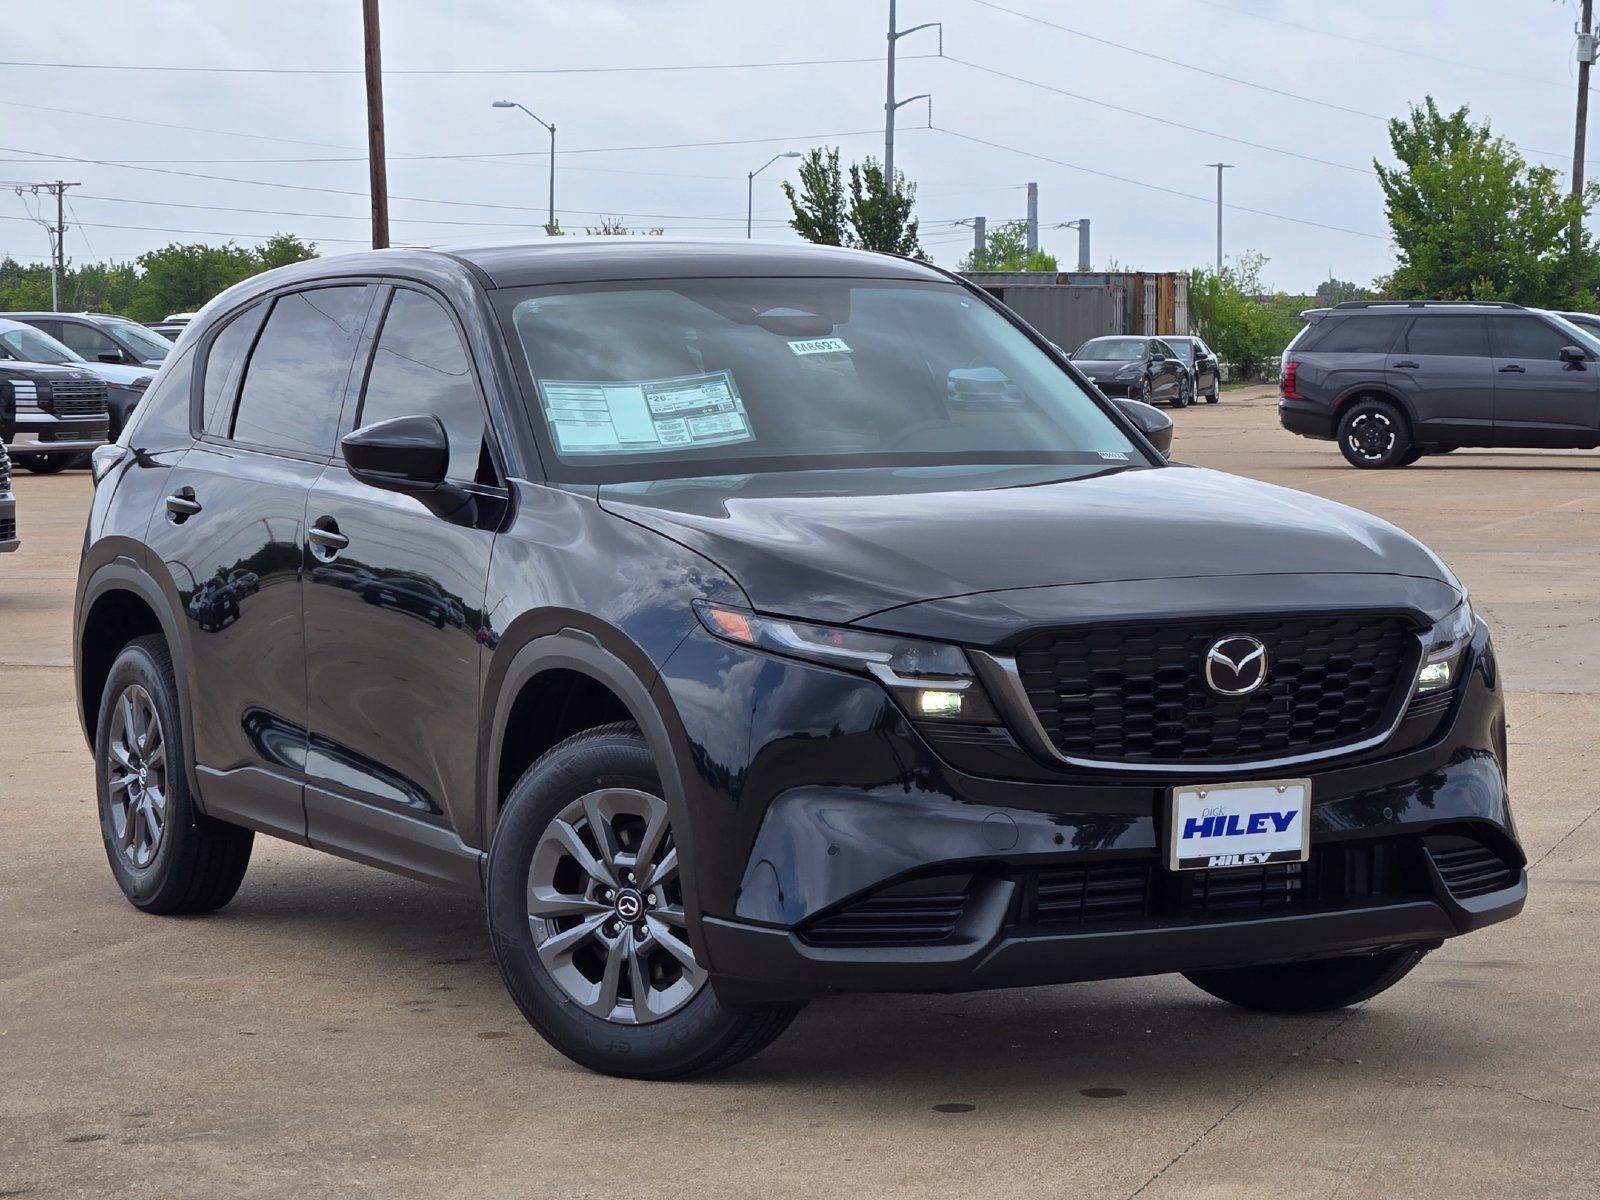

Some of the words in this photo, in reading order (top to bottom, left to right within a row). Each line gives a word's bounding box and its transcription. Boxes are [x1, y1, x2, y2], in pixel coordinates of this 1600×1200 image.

[794, 341, 841, 352] M8693
[1201, 805, 1225, 818] pick
[1182, 810, 1299, 839] HILEY
[1208, 852, 1271, 867] HILEY
